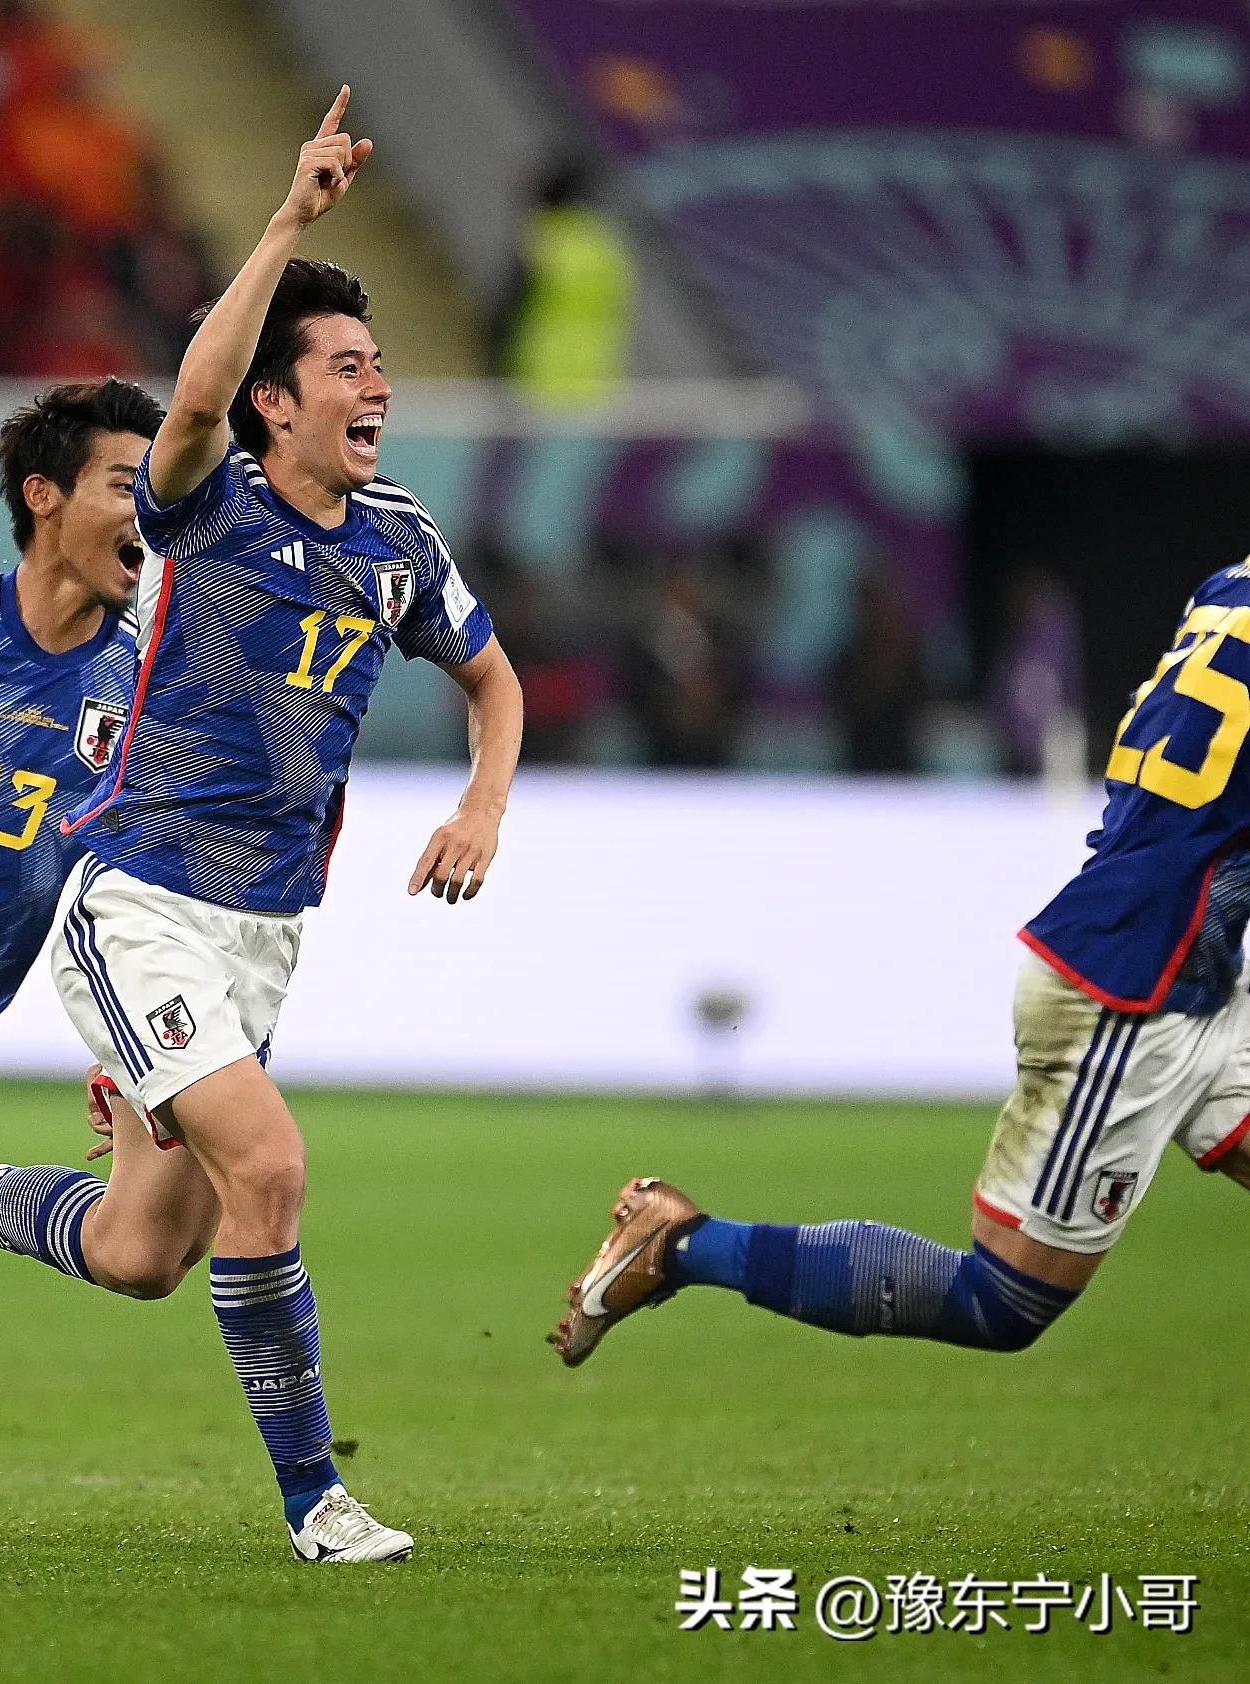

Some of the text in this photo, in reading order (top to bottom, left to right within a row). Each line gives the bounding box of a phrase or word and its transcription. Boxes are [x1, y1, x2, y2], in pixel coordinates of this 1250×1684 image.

[285, 610, 376, 693] 17
[96, 703, 126, 715] JAPAN
[1105, 604, 1250, 810] 25
